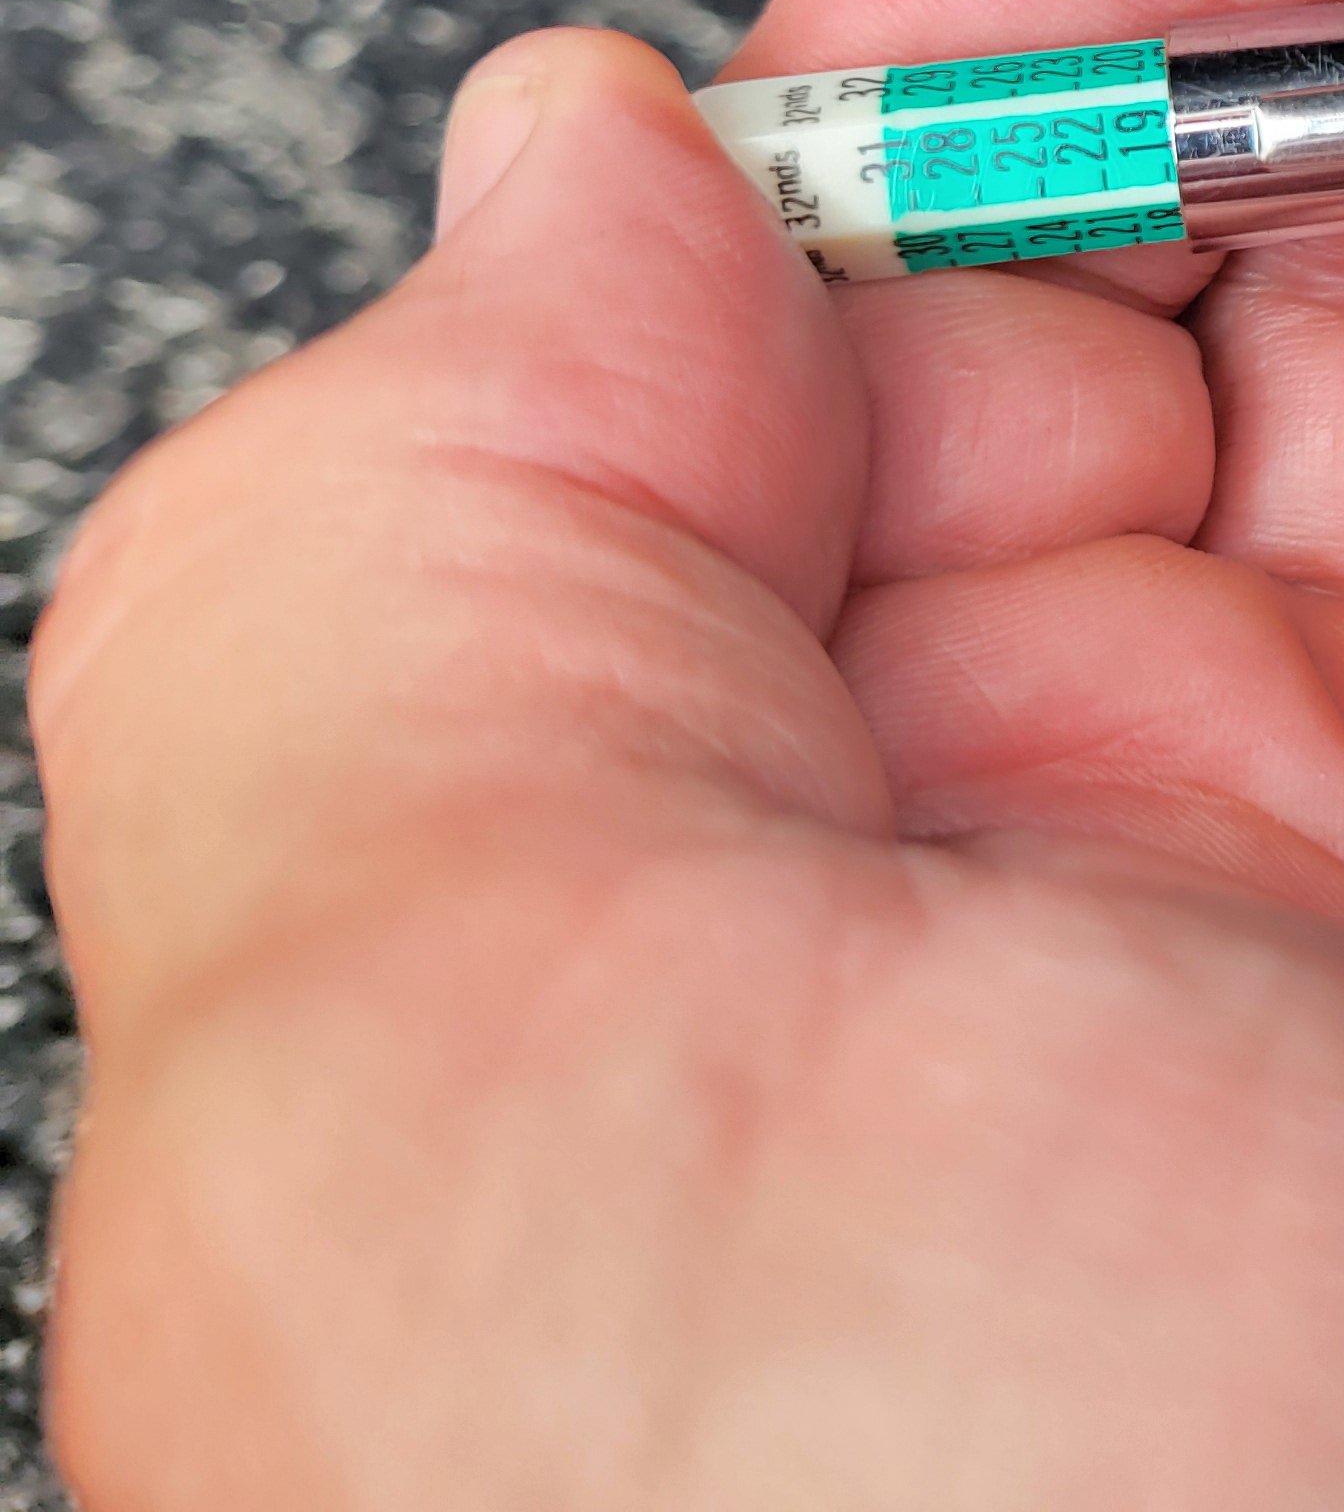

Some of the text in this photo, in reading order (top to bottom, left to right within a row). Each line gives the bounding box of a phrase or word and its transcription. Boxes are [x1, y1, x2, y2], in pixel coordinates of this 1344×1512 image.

[970, 62, 1024, 88] 26
[1030, 56, 1083, 80] 23
[1092, 49, 1144, 75] 20
[838, 73, 893, 101] 32
[903, 70, 957, 95] 29
[991, 122, 1047, 171] 25
[1052, 113, 1107, 164] 22
[1113, 110, 1172, 156] 19
[857, 137, 913, 183] 31
[921, 128, 978, 179] 28
[769, 150, 820, 231] 32nds
[1025, 219, 1082, 244] 24
[1085, 213, 1142, 237] 21
[894, 234, 951, 259] 30
